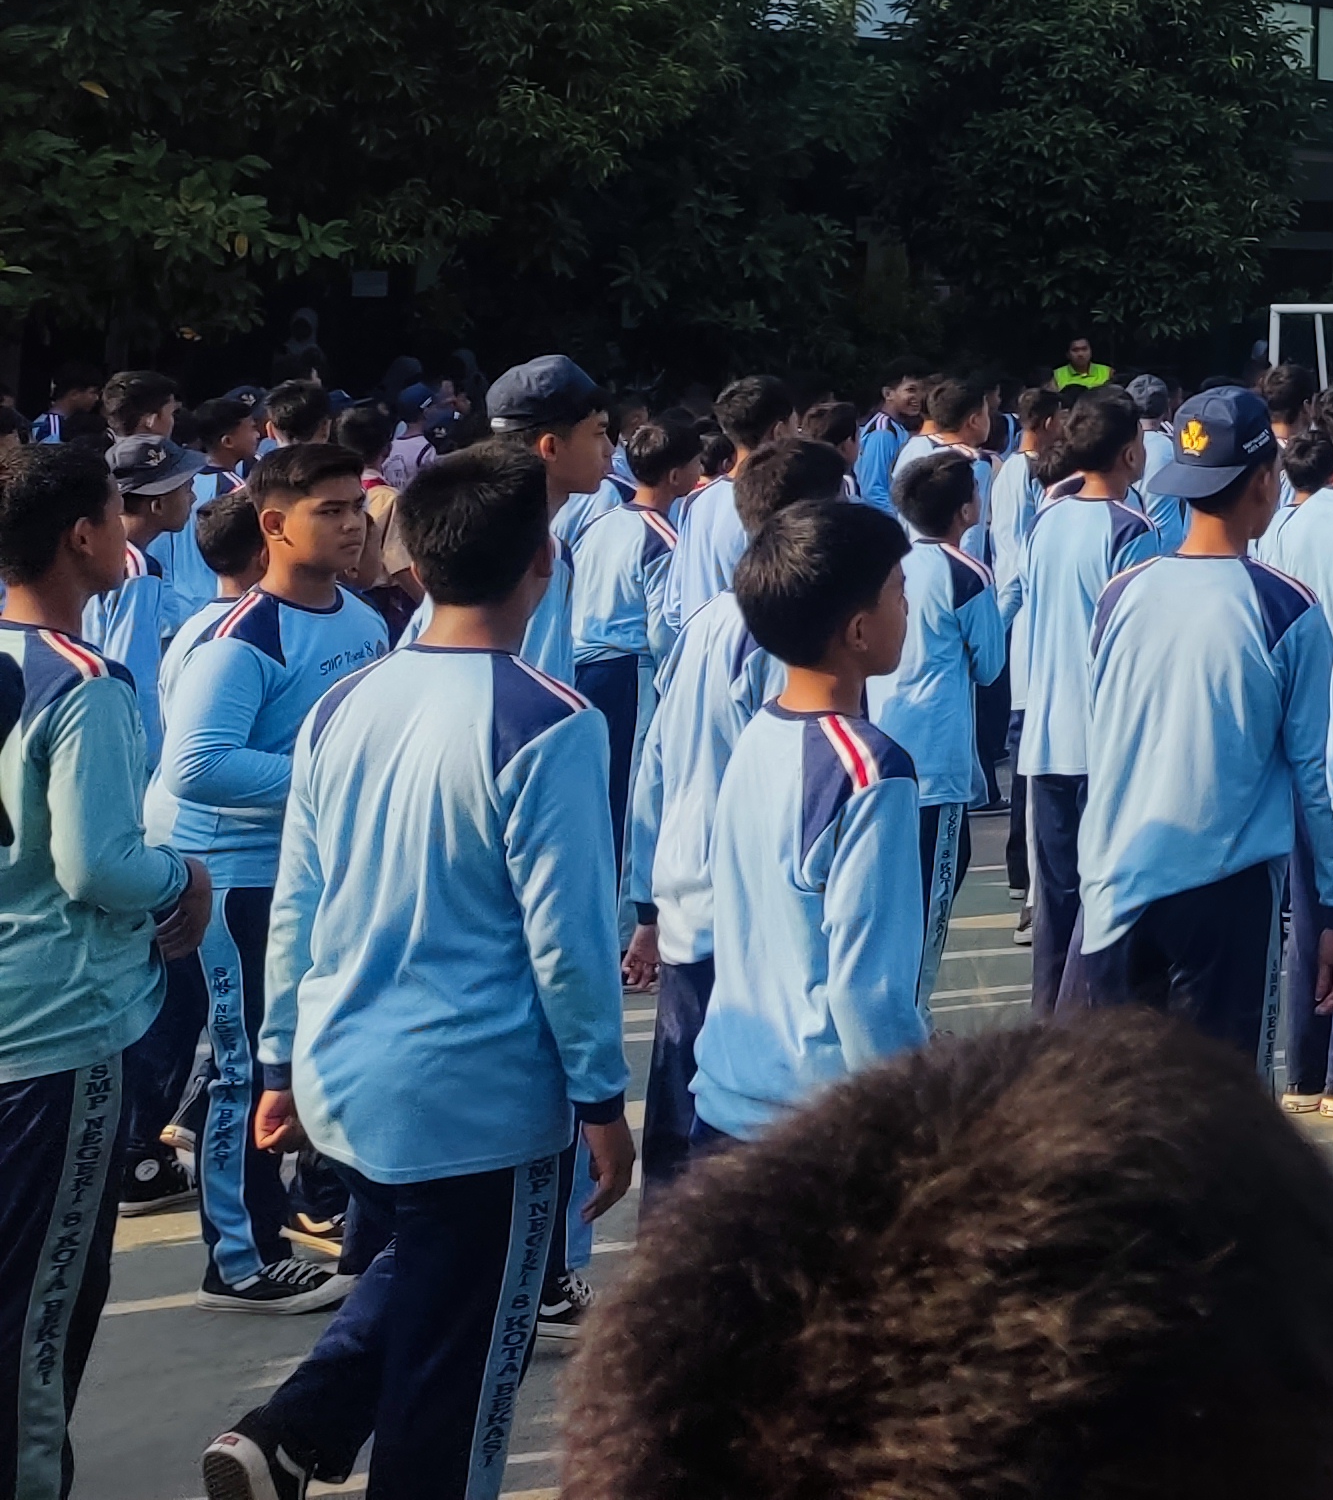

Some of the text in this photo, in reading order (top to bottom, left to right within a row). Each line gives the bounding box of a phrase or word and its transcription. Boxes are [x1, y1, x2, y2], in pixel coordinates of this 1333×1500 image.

[363, 641, 374, 657] 8
[213, 966, 231, 998] SMP
[85, 1063, 113, 1111] SMP
[70, 1115, 106, 1206] NEGERI
[527, 1159, 556, 1195] MP
[62, 1212, 83, 1228] 8
[45, 1231, 81, 1294] KOTA
[511, 1294, 530, 1309] 8
[496, 1314, 531, 1377] KOTA
[480, 1382, 515, 1468] BEKASI
